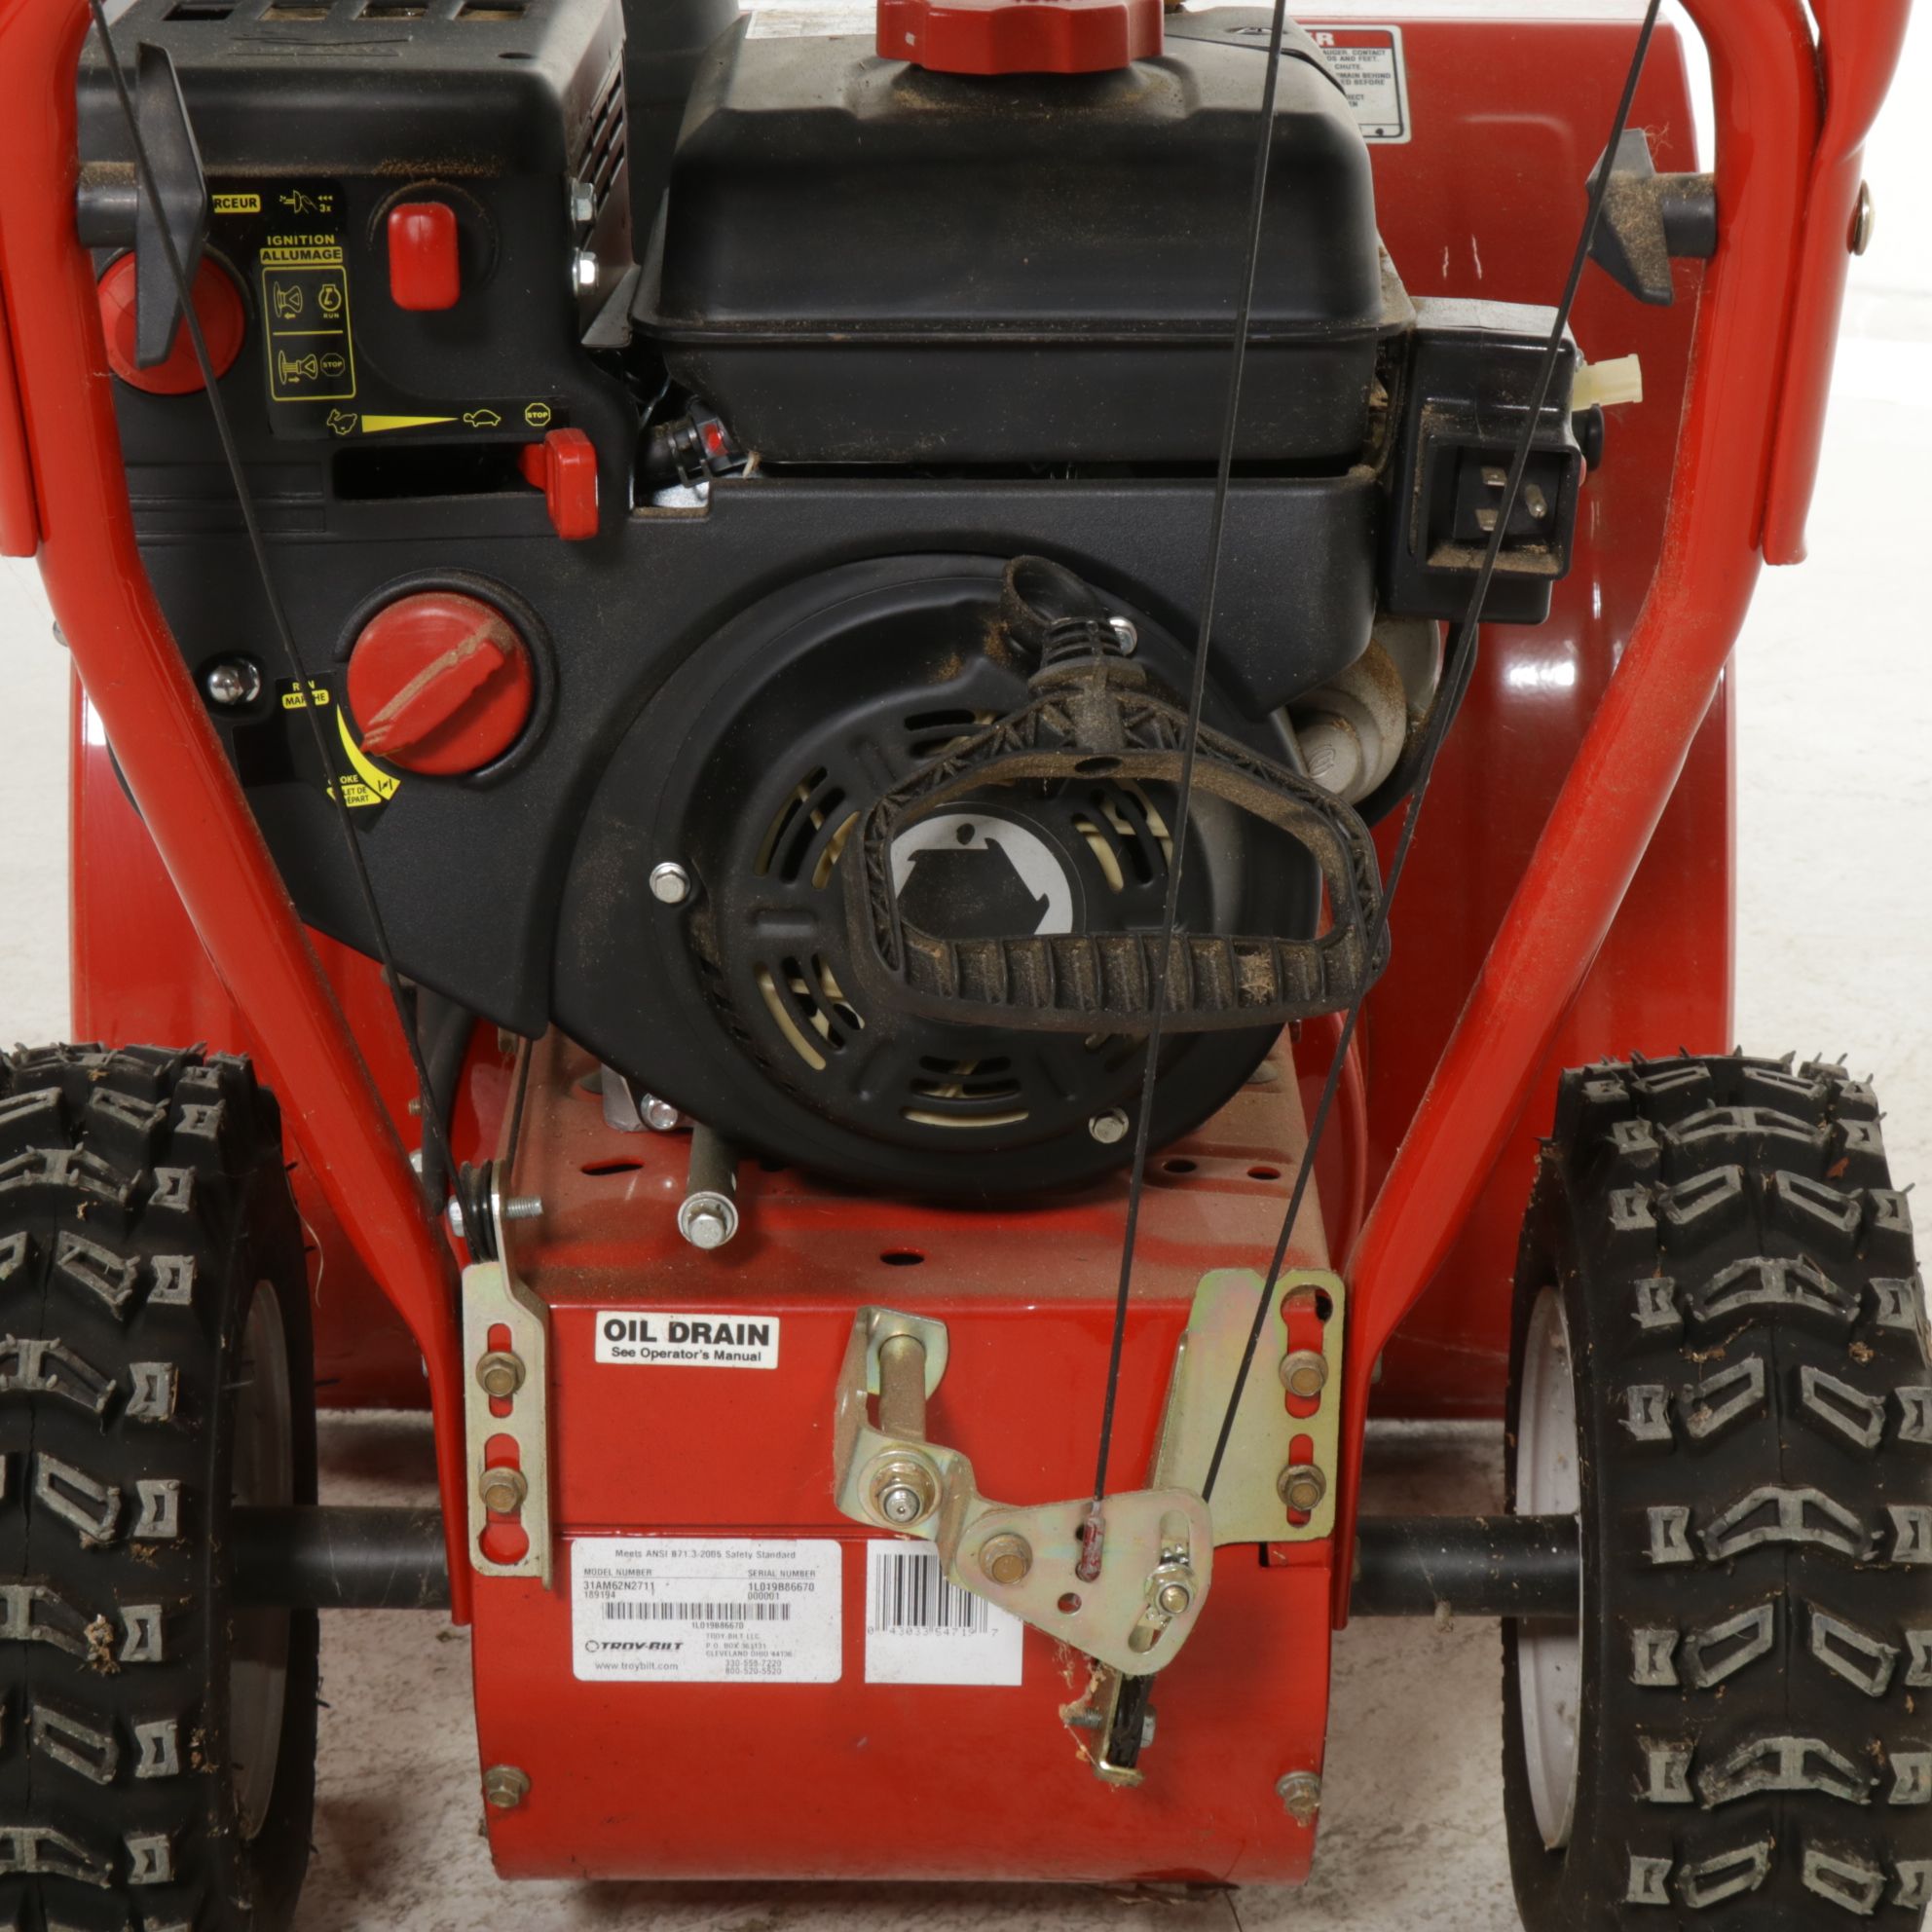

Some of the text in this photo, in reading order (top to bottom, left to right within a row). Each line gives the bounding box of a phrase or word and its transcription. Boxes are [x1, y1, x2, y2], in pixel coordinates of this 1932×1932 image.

[213, 197, 258, 209] RCEUR
[267, 235, 335, 246] IGNITION
[262, 247, 342, 262] ALLUMAGE
[347, 795, 370, 804] EPART
[604, 1319, 769, 1346] OIL DRAIN
[612, 1347, 762, 1361] See Operator's Manual
[614, 1549, 643, 1558] Meets
[646, 1549, 668, 1558] ANSI
[724, 1550, 753, 1560] Safety
[756, 1550, 796, 1559] Standard
[601, 1641, 684, 1651] TROY-BILT
[595, 1661, 679, 1671] www.troybilt.com
